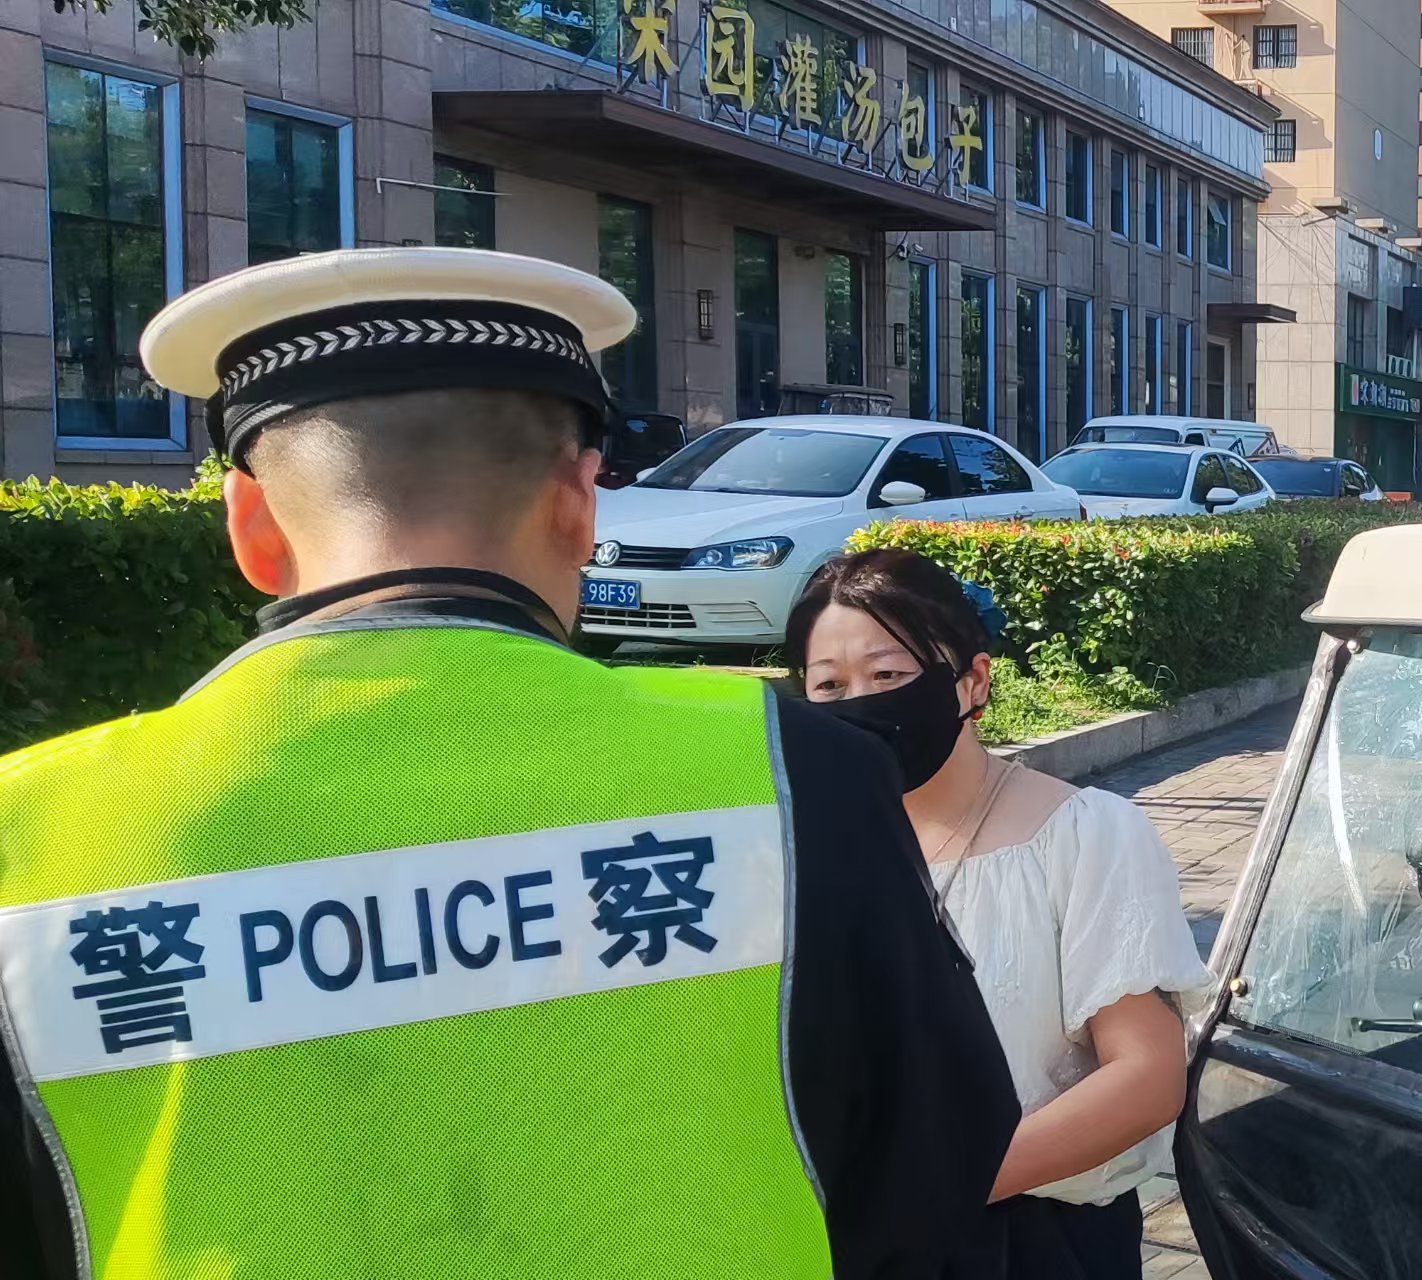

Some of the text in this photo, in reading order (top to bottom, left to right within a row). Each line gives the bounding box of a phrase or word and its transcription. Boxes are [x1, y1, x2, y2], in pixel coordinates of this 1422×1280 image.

[588, 583, 636, 603] 98F39
[70, 831, 719, 1054] 警 POLICE 察
